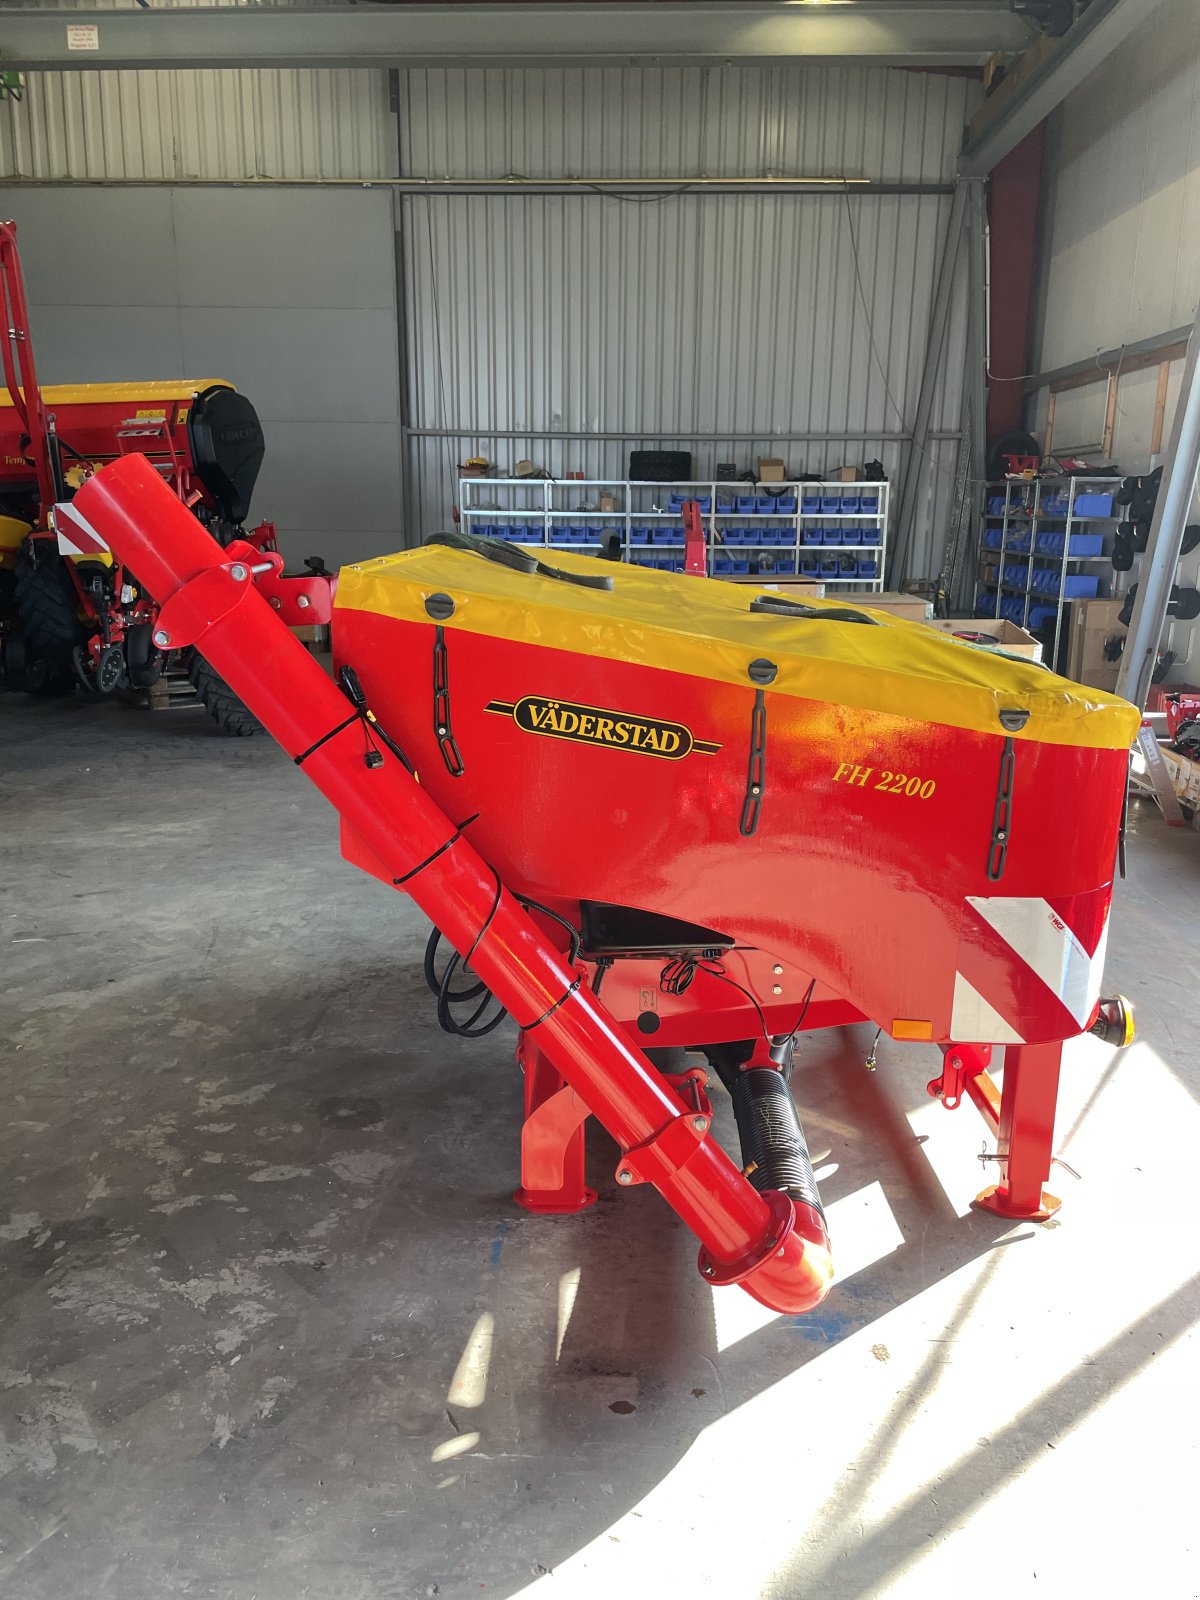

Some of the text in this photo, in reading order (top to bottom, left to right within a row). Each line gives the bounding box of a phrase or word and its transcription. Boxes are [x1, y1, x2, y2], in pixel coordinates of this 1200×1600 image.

[528, 702, 680, 752] VÄDERSTAD
[832, 762, 936, 799] FH 2200
